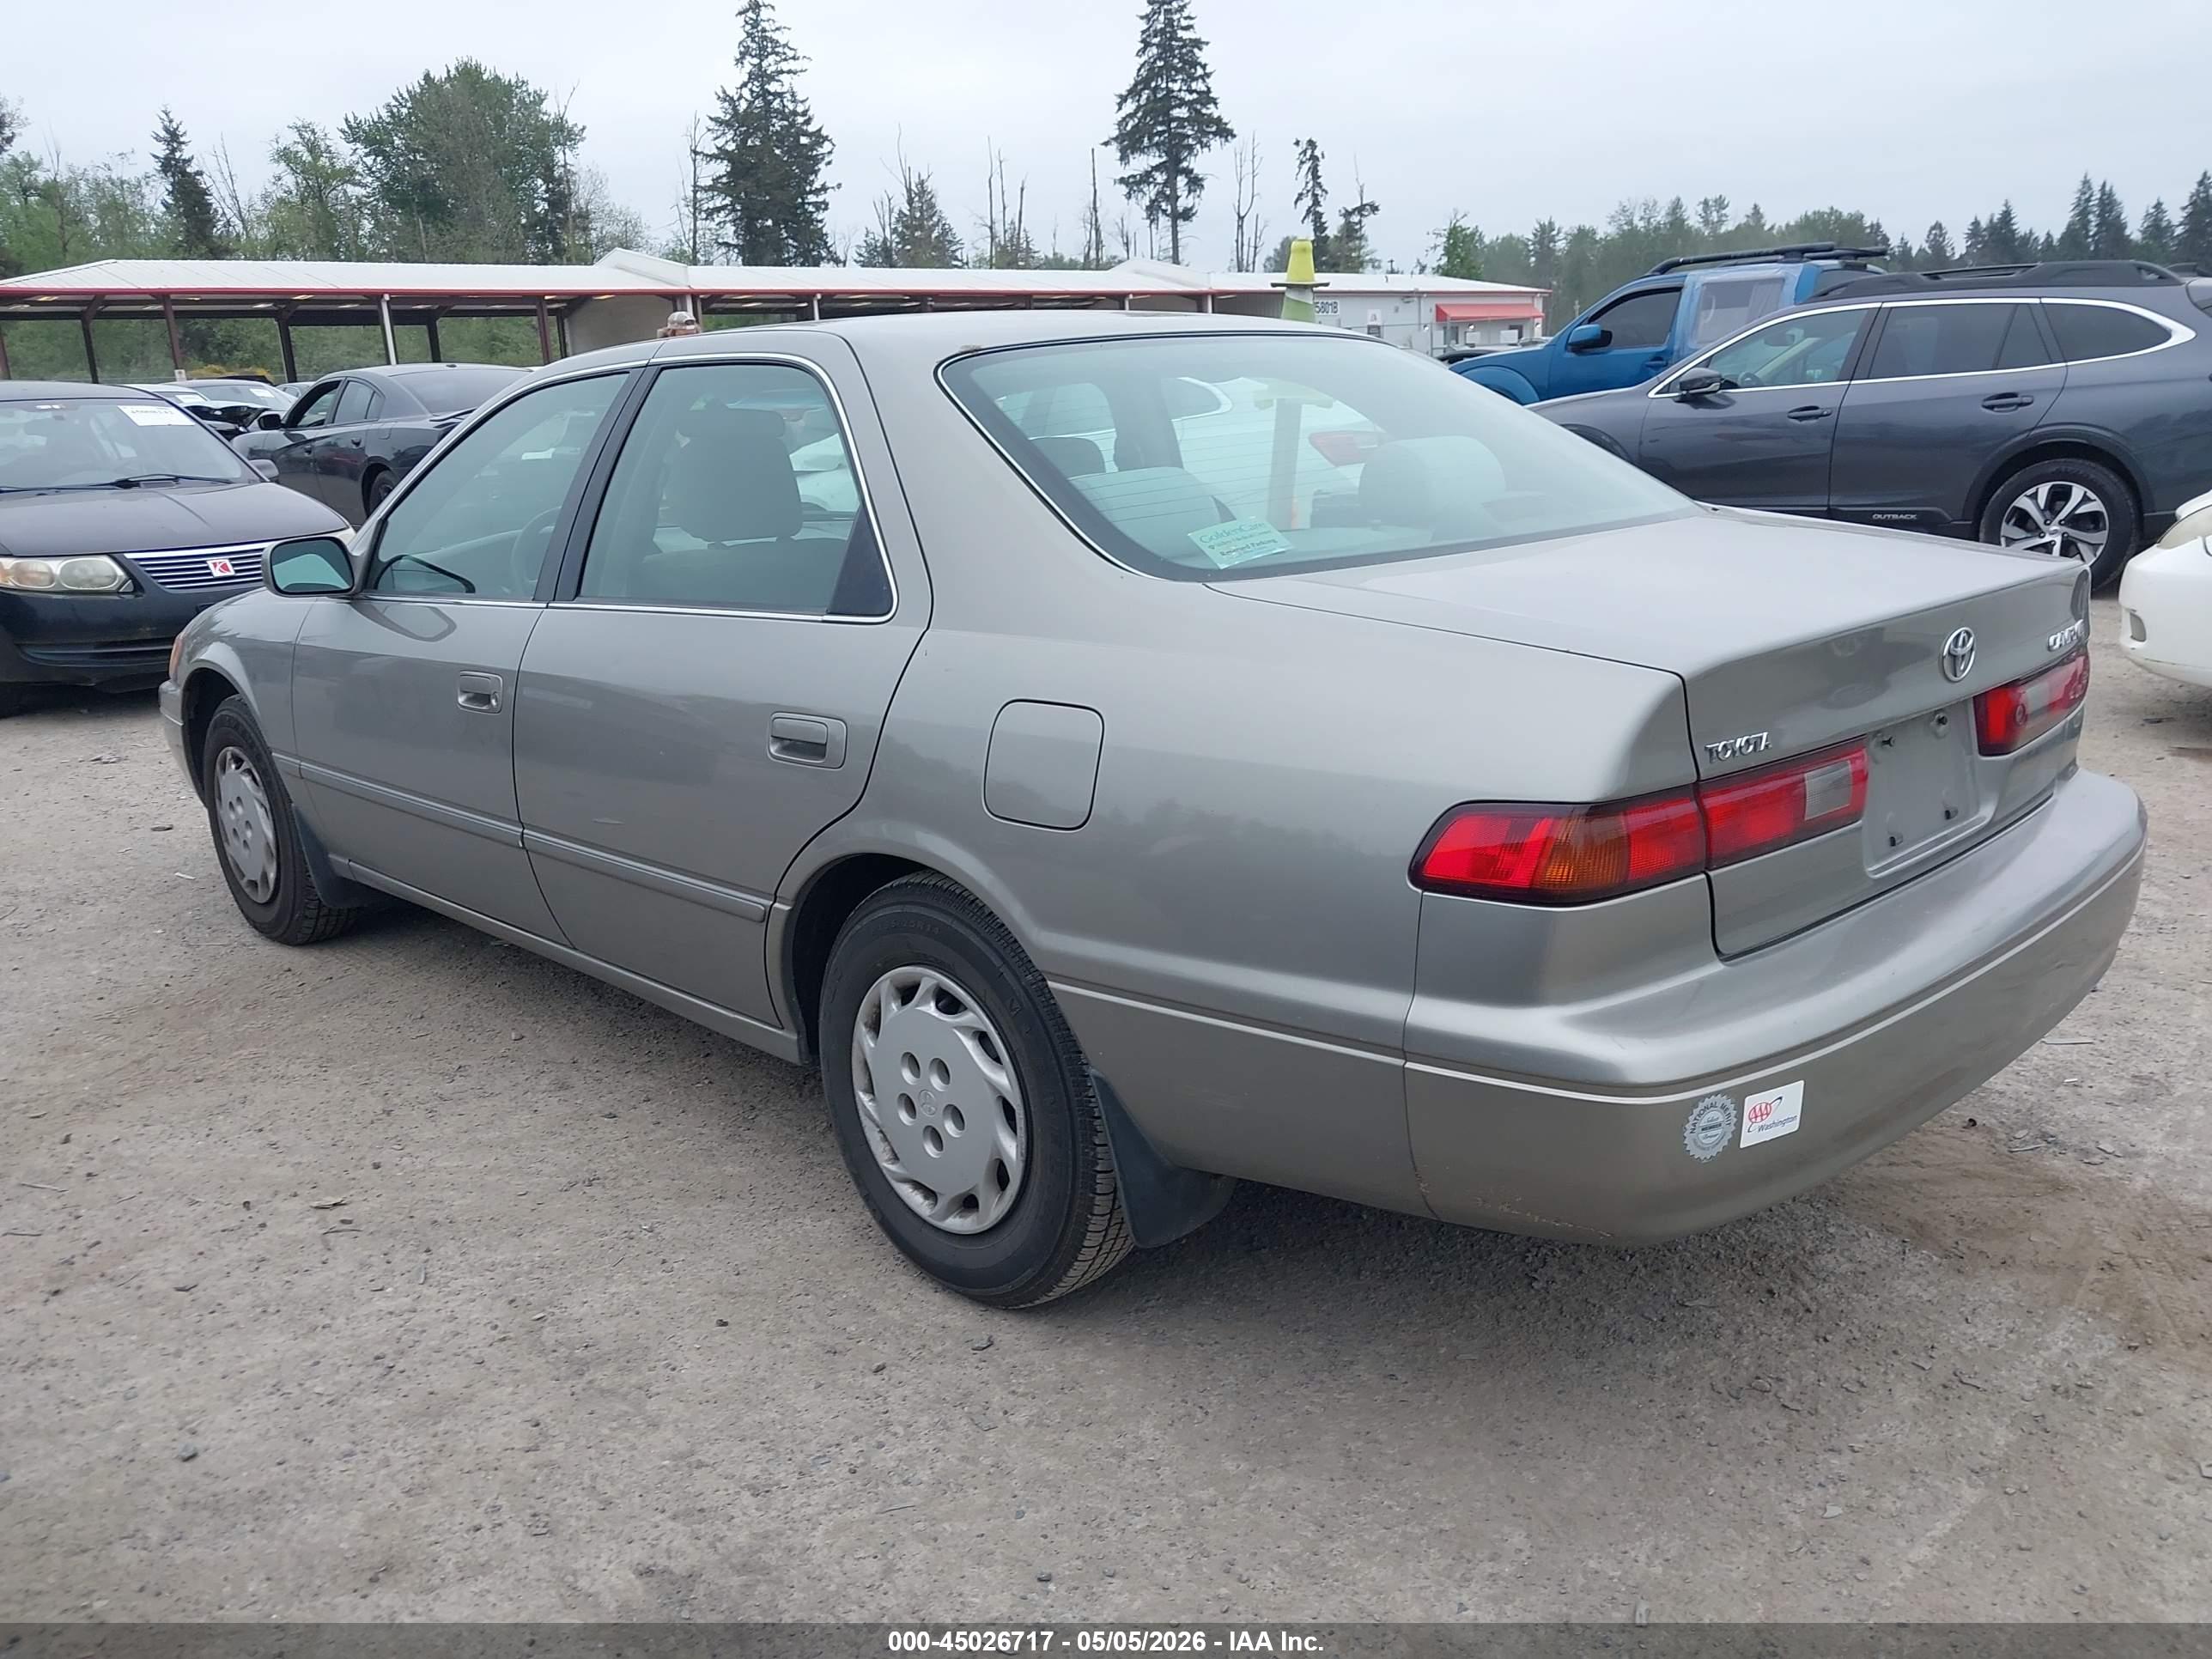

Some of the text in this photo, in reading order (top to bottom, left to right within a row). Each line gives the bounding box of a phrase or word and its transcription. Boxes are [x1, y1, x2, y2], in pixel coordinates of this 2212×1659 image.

[1705, 732, 1772, 763] TOYOTA
[1690, 1102, 1732, 1133] NATIONAL MERIT
[1758, 1115, 1797, 1133] Washington
